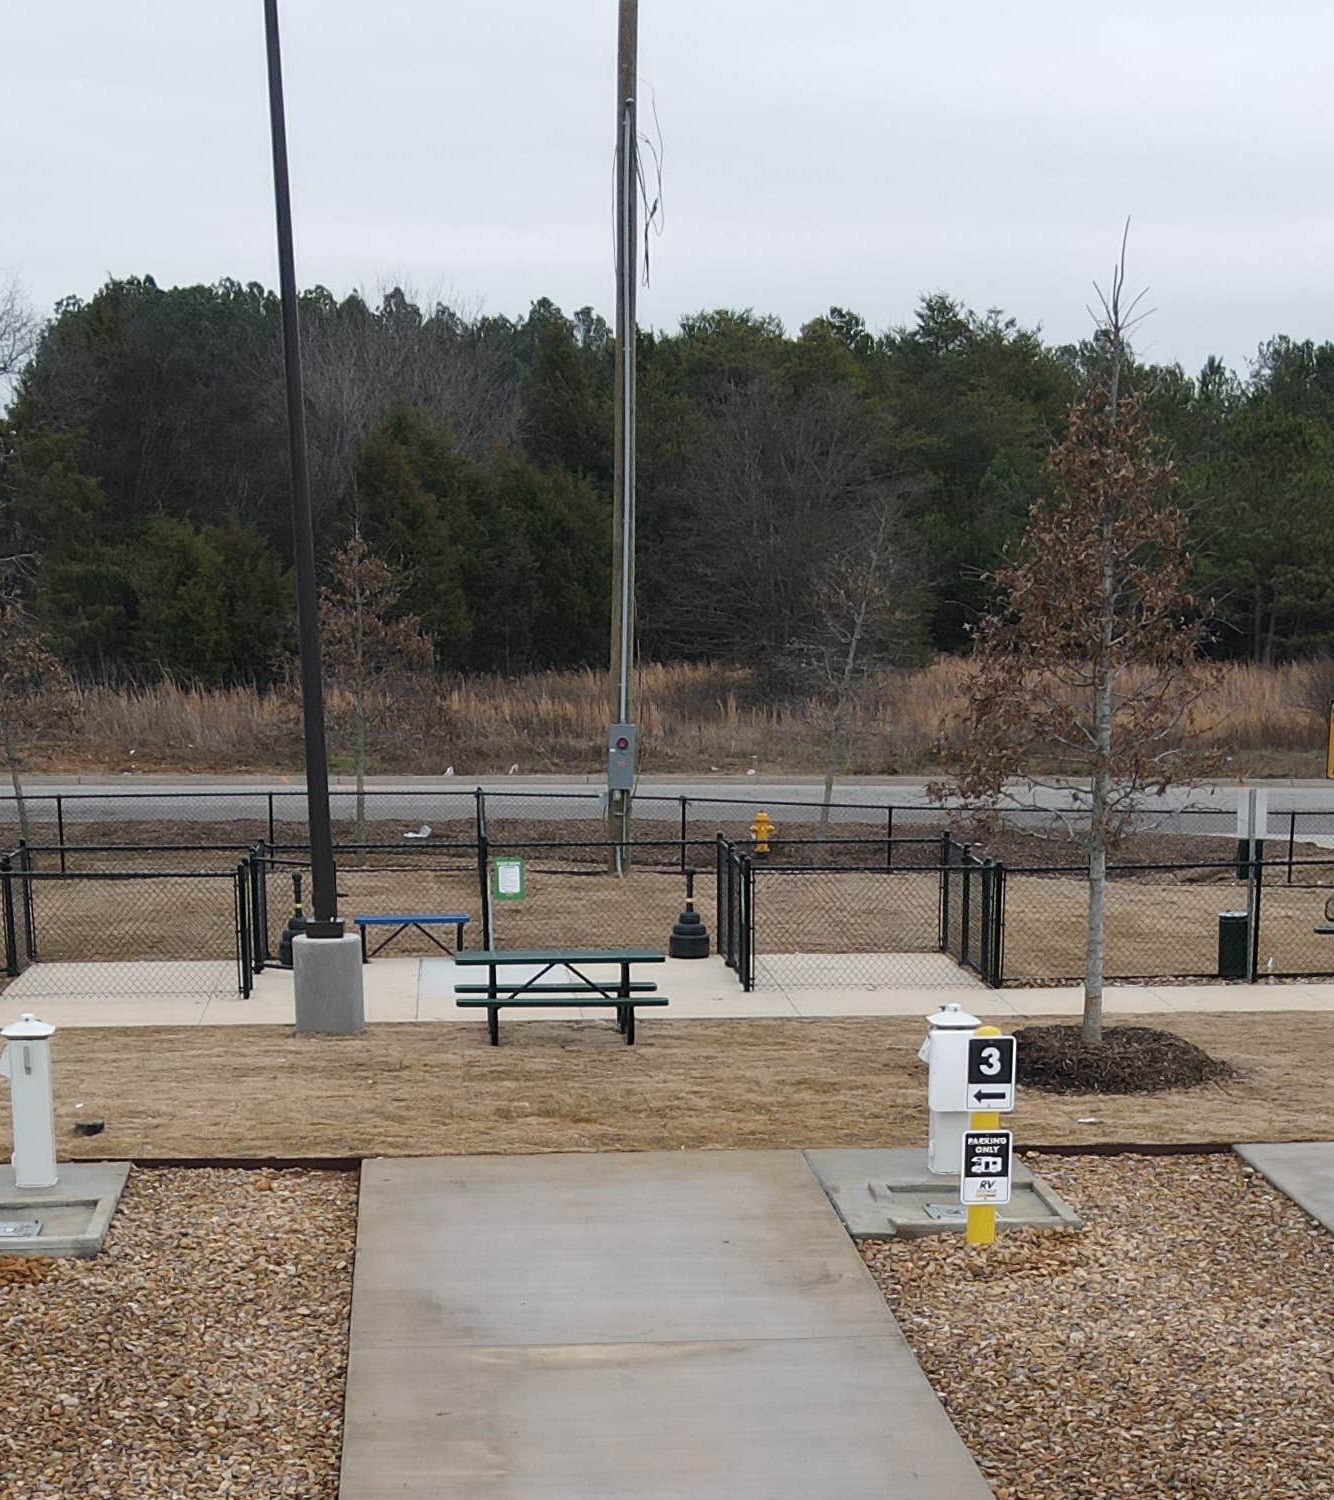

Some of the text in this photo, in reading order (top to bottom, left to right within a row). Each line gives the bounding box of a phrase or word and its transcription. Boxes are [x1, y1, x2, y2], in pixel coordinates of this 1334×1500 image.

[979, 1047, 1001, 1076] 3
[967, 1137, 1007, 1145] PARKING
[975, 1146, 1001, 1154] ONLY
[979, 1180, 995, 1189] RV
